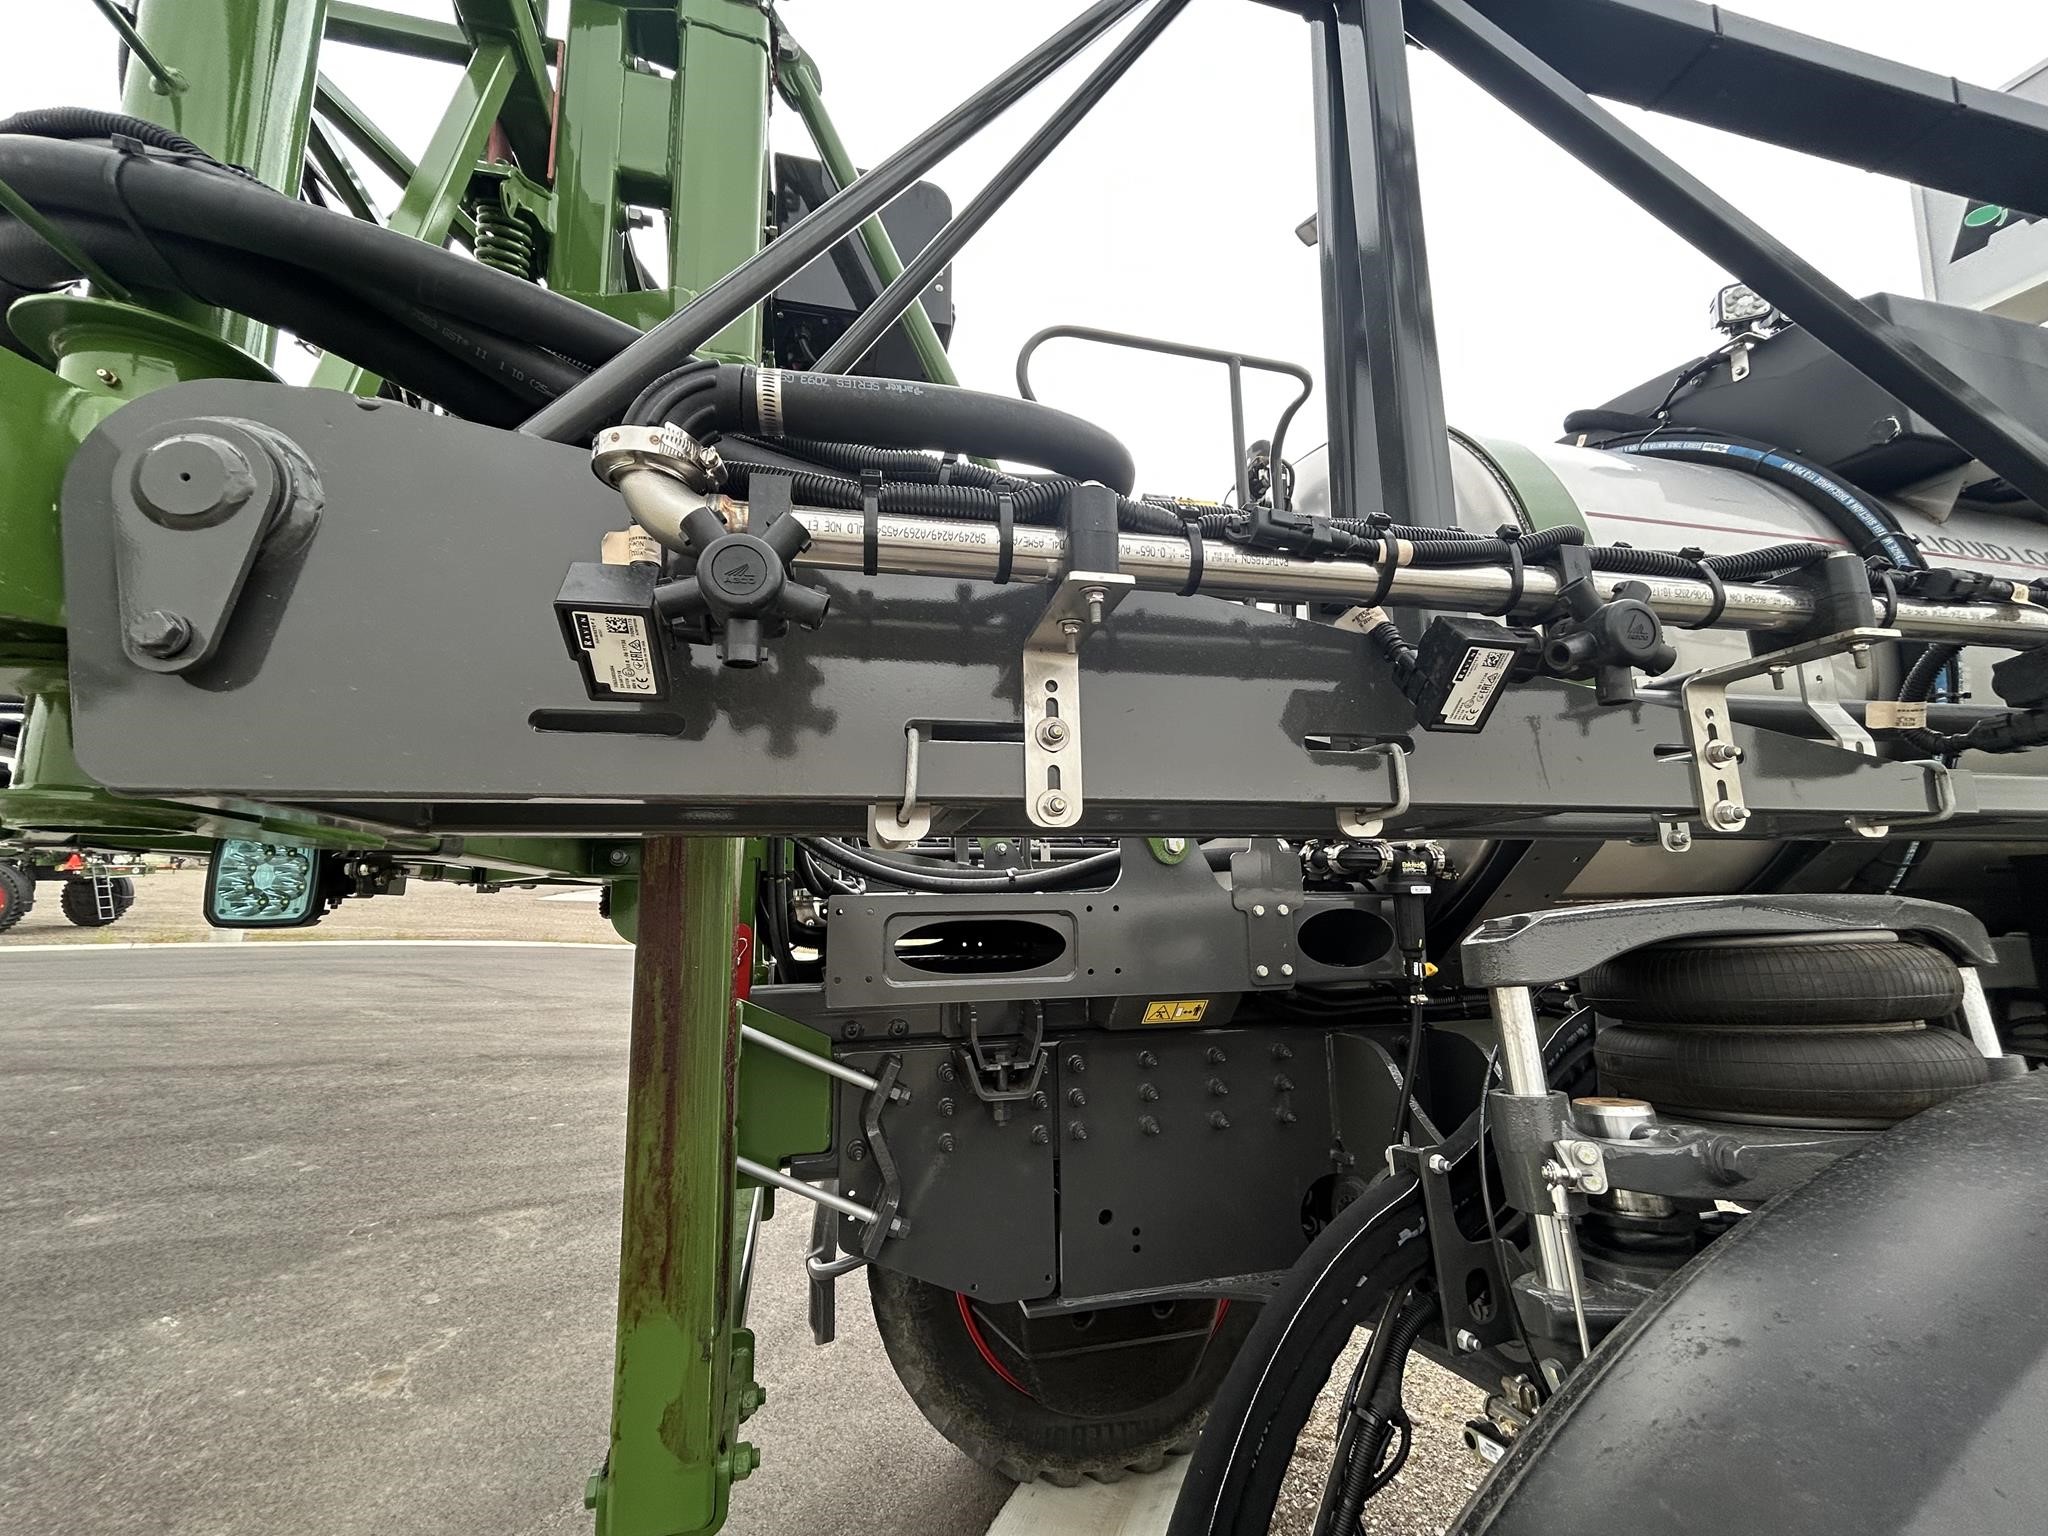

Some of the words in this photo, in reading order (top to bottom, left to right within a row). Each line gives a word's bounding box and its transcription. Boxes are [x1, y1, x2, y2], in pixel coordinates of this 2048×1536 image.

[800, 375, 830, 387] 7093
[836, 380, 880, 391] SERIES
[885, 385, 924, 396] Parker
[1814, 473, 1849, 505] DISCHARGE
[1849, 501, 1877, 526] SUCTION
[1911, 532, 2011, 562] LIQUID
[2008, 546, 2048, 567] LO
[580, 617, 593, 646] RAVEN
[636, 677, 650, 690] CE
